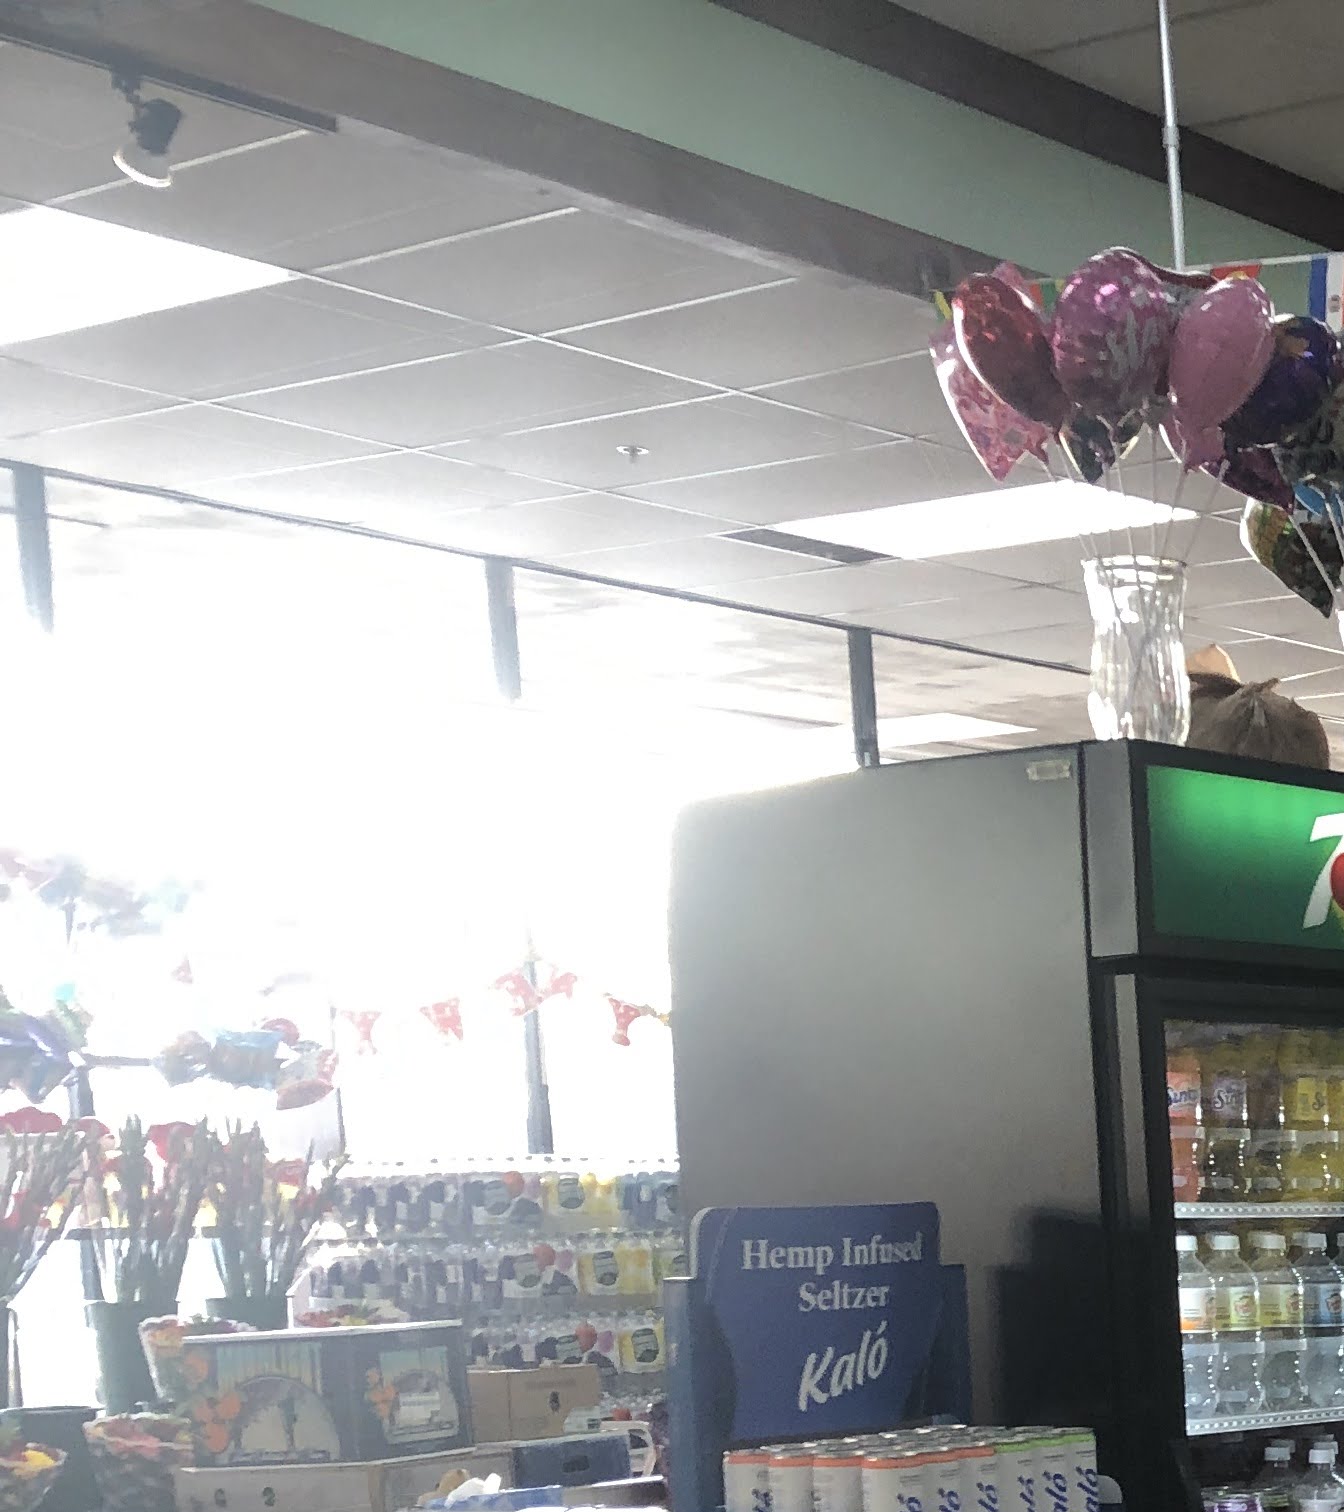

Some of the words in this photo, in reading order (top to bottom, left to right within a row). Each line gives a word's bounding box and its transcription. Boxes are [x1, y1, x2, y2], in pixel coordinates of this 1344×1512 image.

[741, 1239, 834, 1275] Hemp
[842, 1231, 923, 1266] Infused
[799, 1280, 890, 1312] Seltzer
[798, 1320, 888, 1412] Kaló
